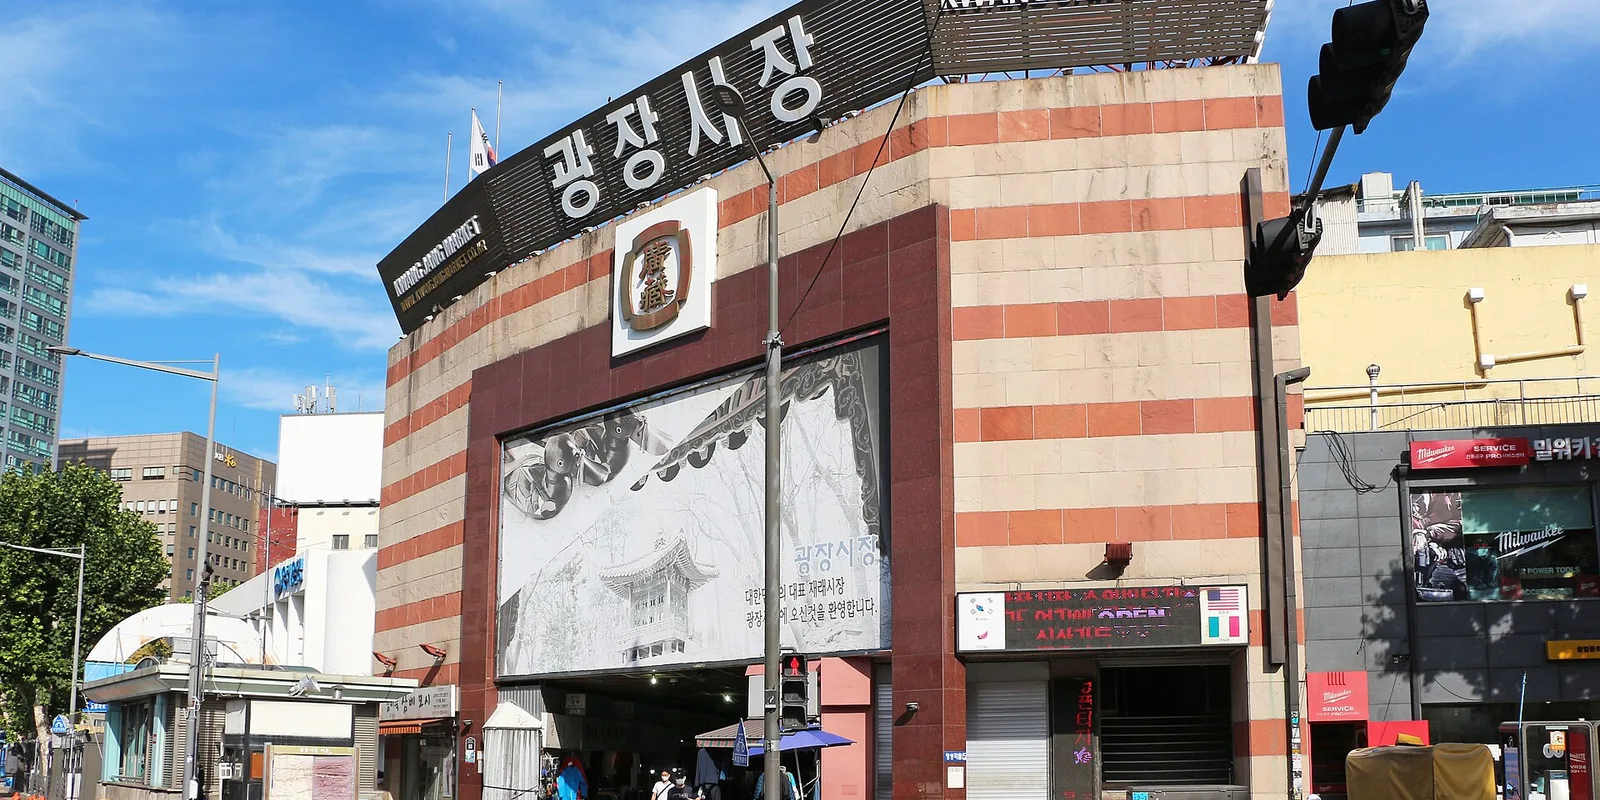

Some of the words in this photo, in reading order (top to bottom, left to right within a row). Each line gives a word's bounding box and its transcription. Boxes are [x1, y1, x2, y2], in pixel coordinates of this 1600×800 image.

[544, 15, 822, 219] 광장시장
[441, 214, 482, 258] MARKET
[1416, 445, 1456, 461] Milwaukee
[1473, 444, 1516, 452] SERVICE
[1533, 436, 1591, 461] 밀워키
[1494, 525, 1564, 552] Milwaukee
[794, 534, 878, 575] 광장시장
[1527, 567, 1554, 575] POWER
[1556, 566, 1580, 574] TOOLS
[745, 584, 787, 606] 대한의
[789, 582, 806, 600] 대표
[808, 577, 845, 598] 재래시장
[746, 606, 788, 629] 광장에
[790, 603, 826, 623] 오신것을
[828, 597, 878, 620] 환영합니다.
